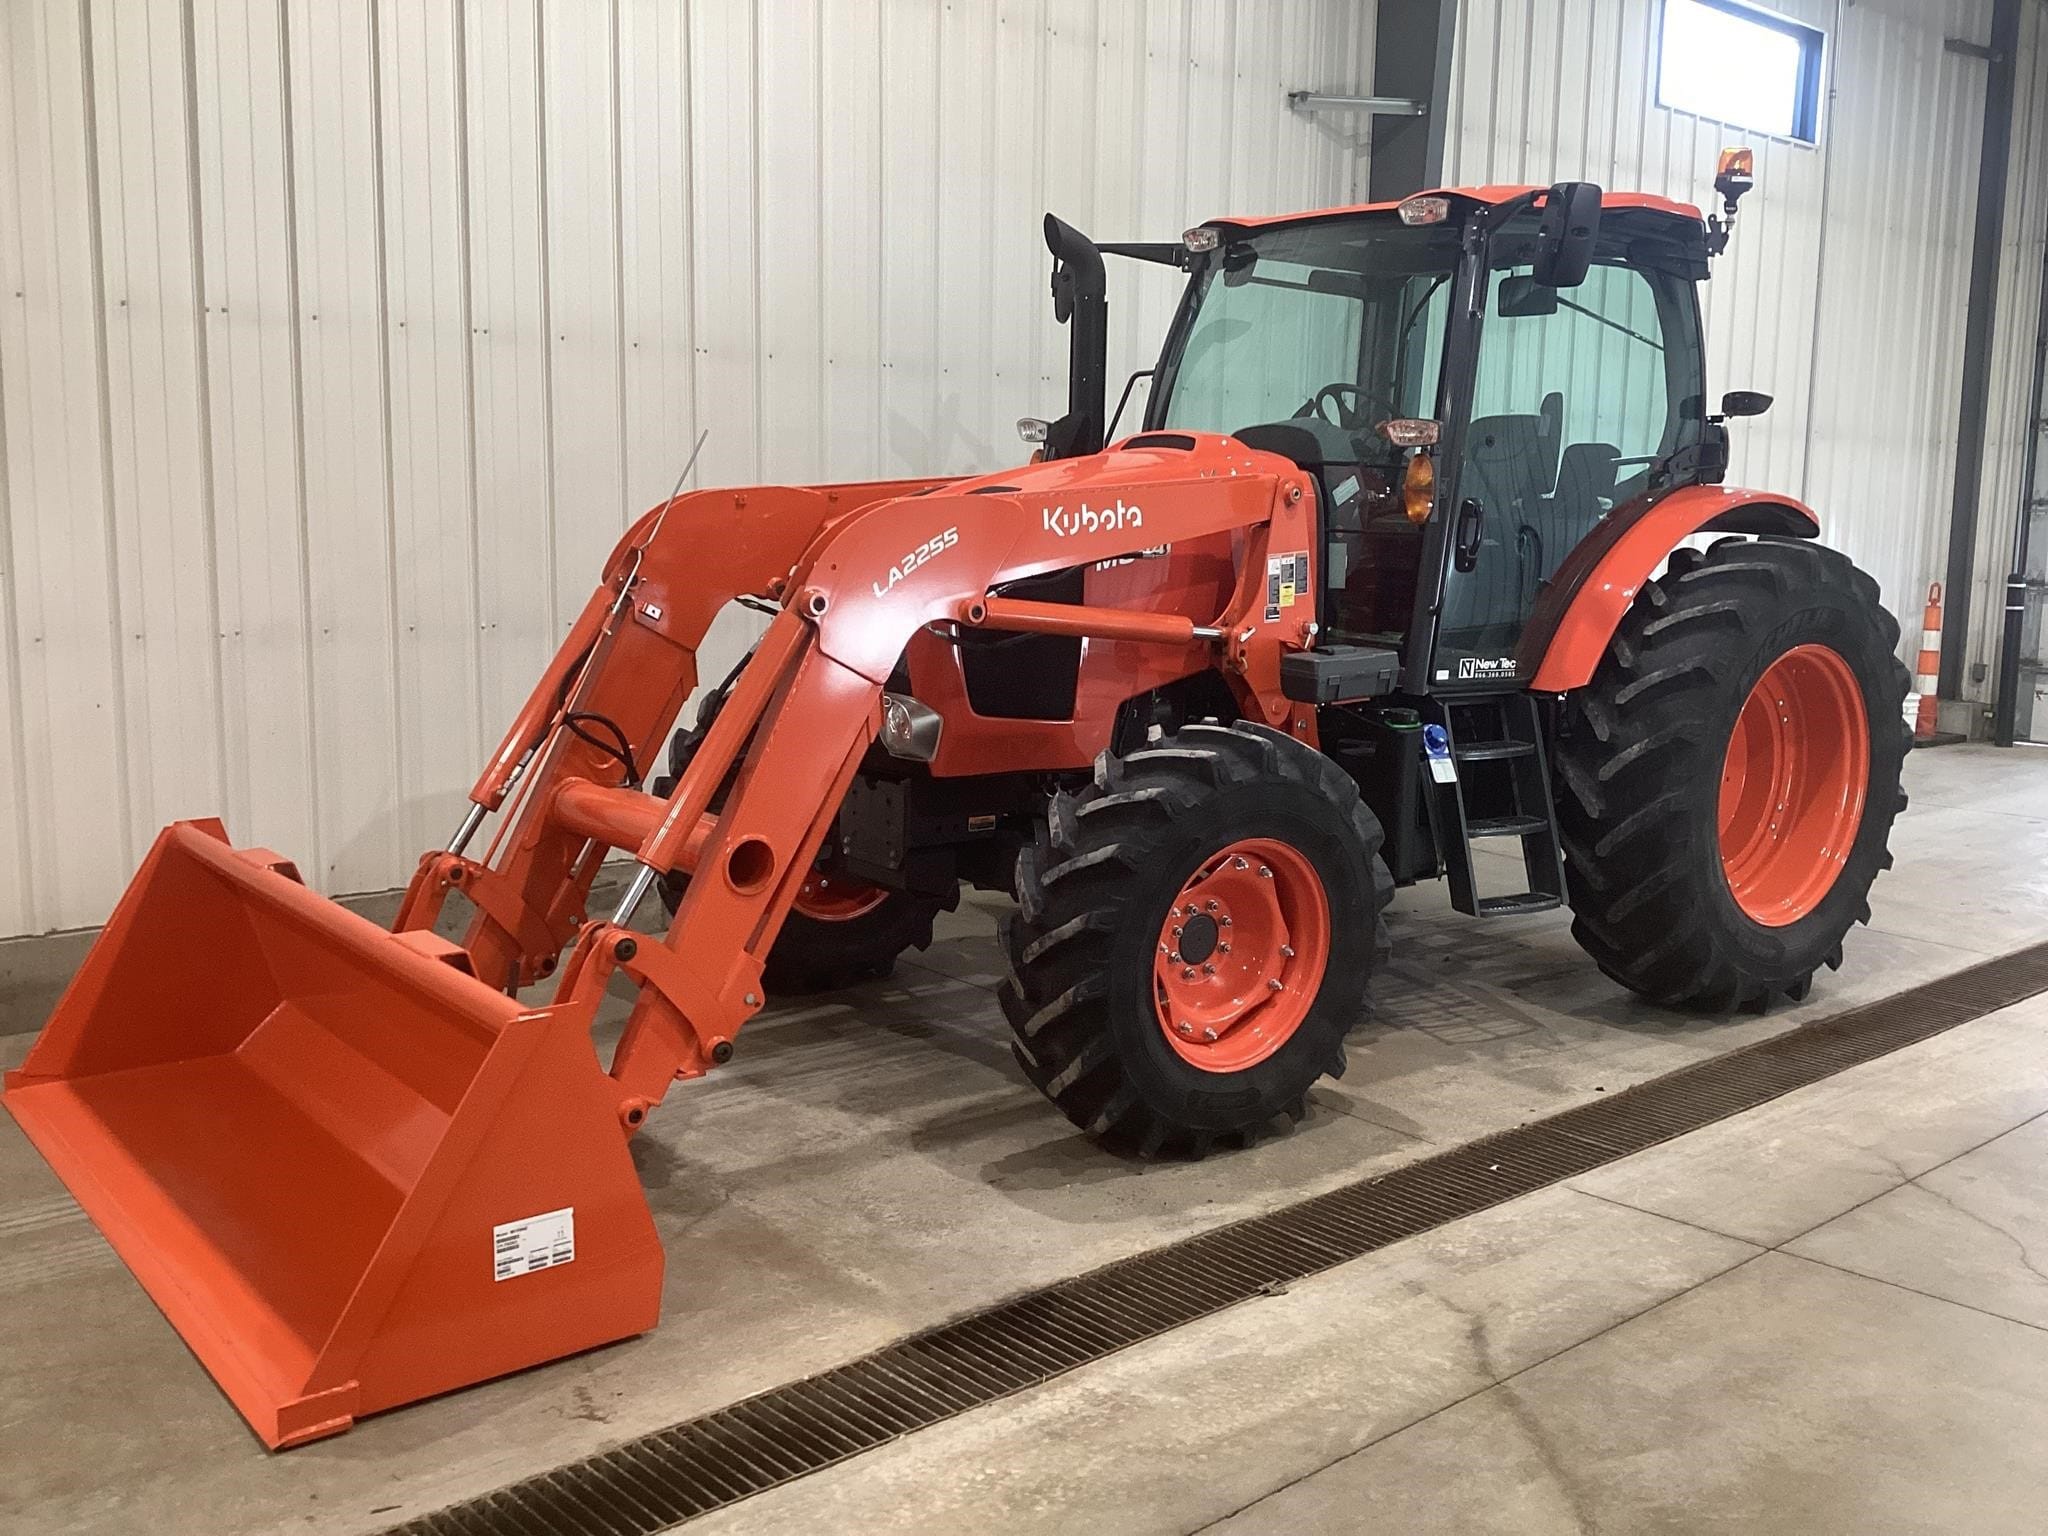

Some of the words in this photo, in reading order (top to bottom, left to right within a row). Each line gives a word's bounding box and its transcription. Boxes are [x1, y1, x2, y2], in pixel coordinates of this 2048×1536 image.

[1043, 499, 1143, 537] Kubota
[872, 526, 959, 598] LA2255
[1475, 658, 1499, 670] New
[1499, 657, 1517, 669] Tec
